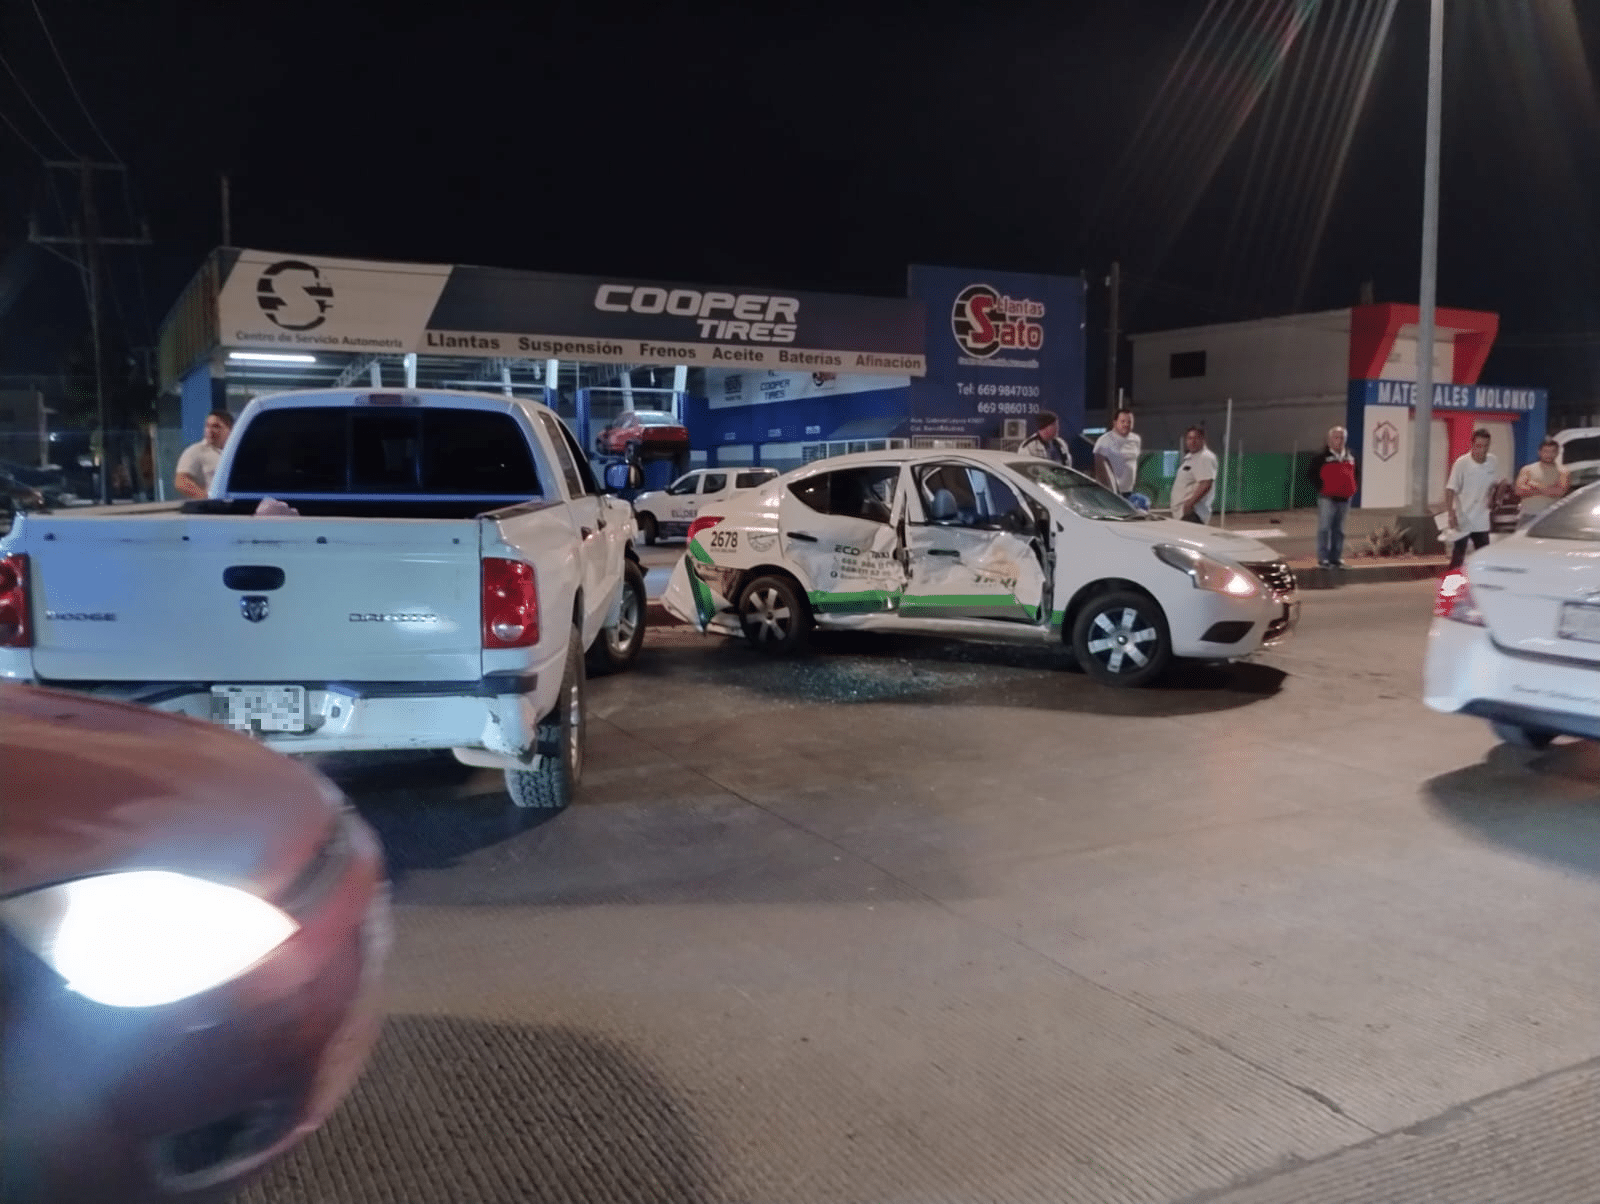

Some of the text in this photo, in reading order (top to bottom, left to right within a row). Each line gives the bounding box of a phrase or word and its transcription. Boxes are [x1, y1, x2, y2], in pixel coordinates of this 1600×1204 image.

[595, 284, 800, 322] COOPER
[236, 330, 275, 342] Centro
[278, 332, 292, 342] de
[295, 333, 338, 345] Servicio
[697, 319, 797, 343] TIRES
[427, 333, 500, 349] Llantas
[519, 337, 623, 355] Suspensión
[640, 343, 696, 359] Frenos
[712, 347, 764, 361] Aceite
[856, 354, 921, 369] Afinación
[978, 384, 997, 396] 669
[1378, 381, 1535, 410] MATEALES MOLONKO
[978, 402, 997, 414] 669
[711, 531, 738, 548] 2678
[834, 544, 860, 556] ECO
